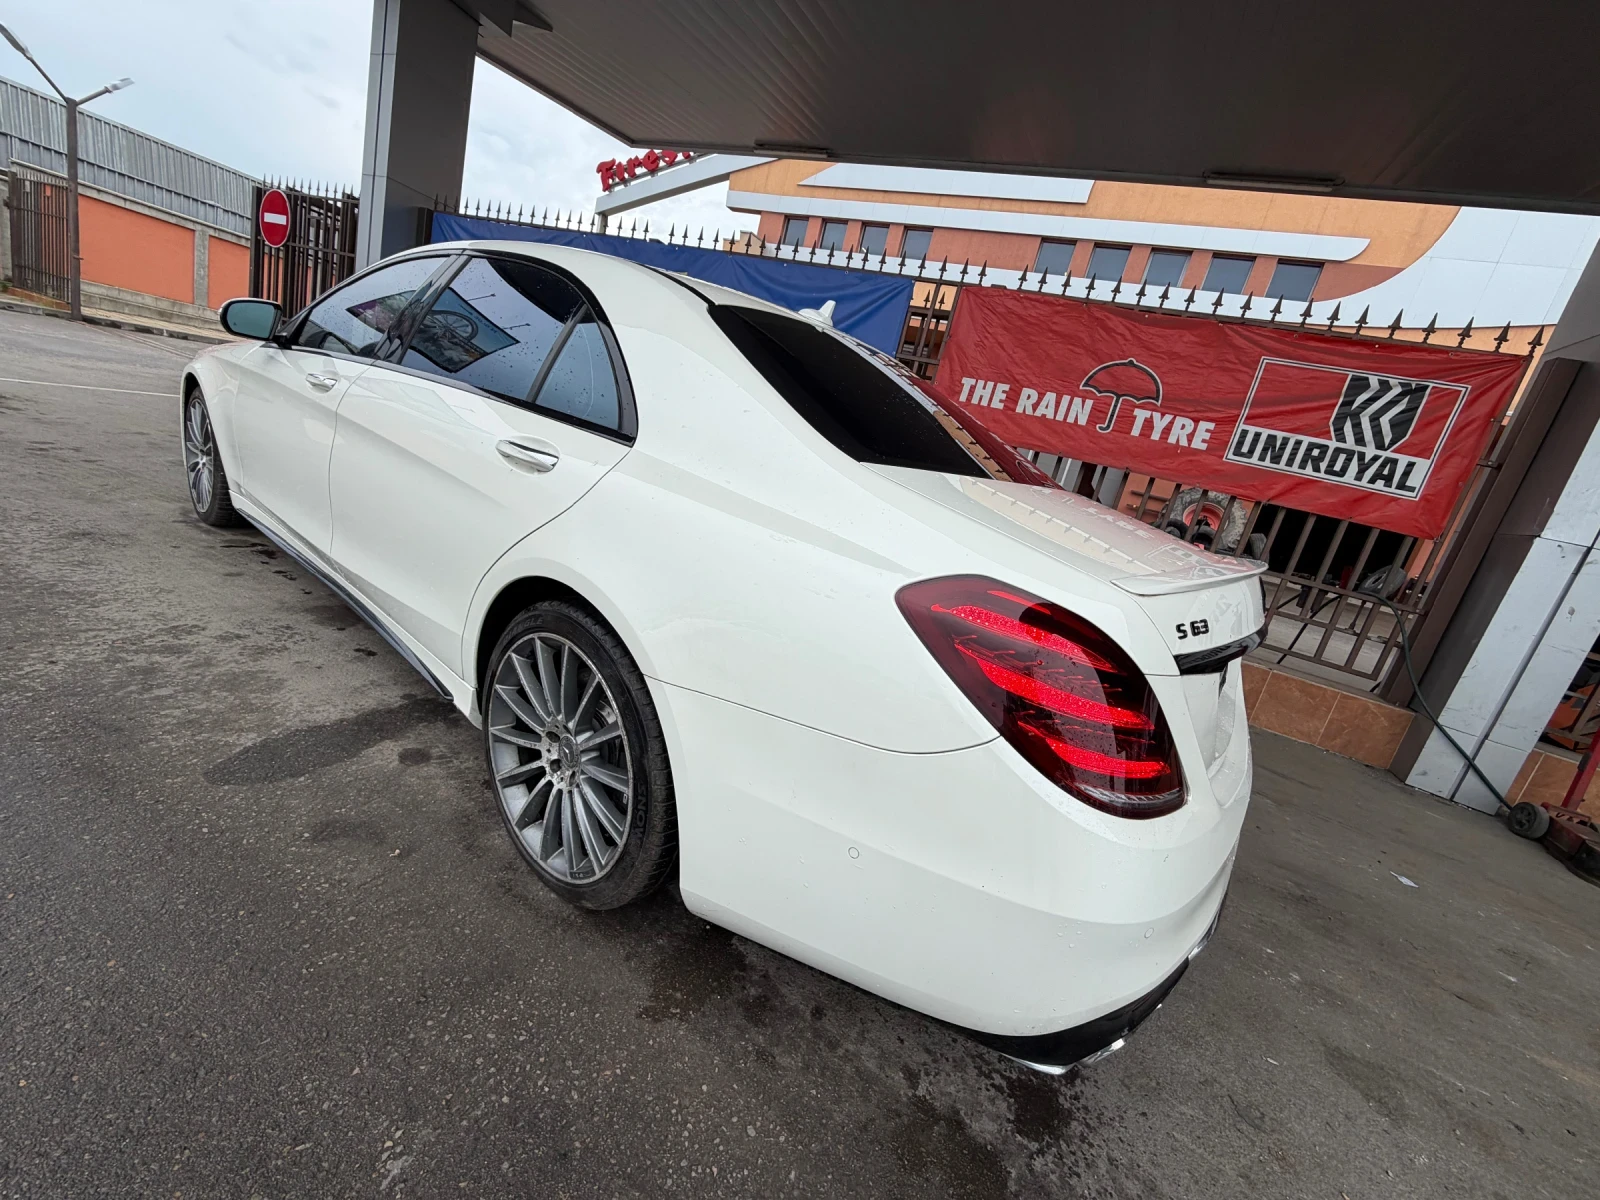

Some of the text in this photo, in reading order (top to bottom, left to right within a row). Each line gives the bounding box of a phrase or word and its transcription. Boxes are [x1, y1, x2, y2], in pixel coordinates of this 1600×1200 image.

[596, 149, 692, 192] Fires
[958, 377, 1215, 450] THE RAIN TYRE
[1232, 428, 1417, 493] UNIROYAL
[1175, 618, 1210, 640] S 63
